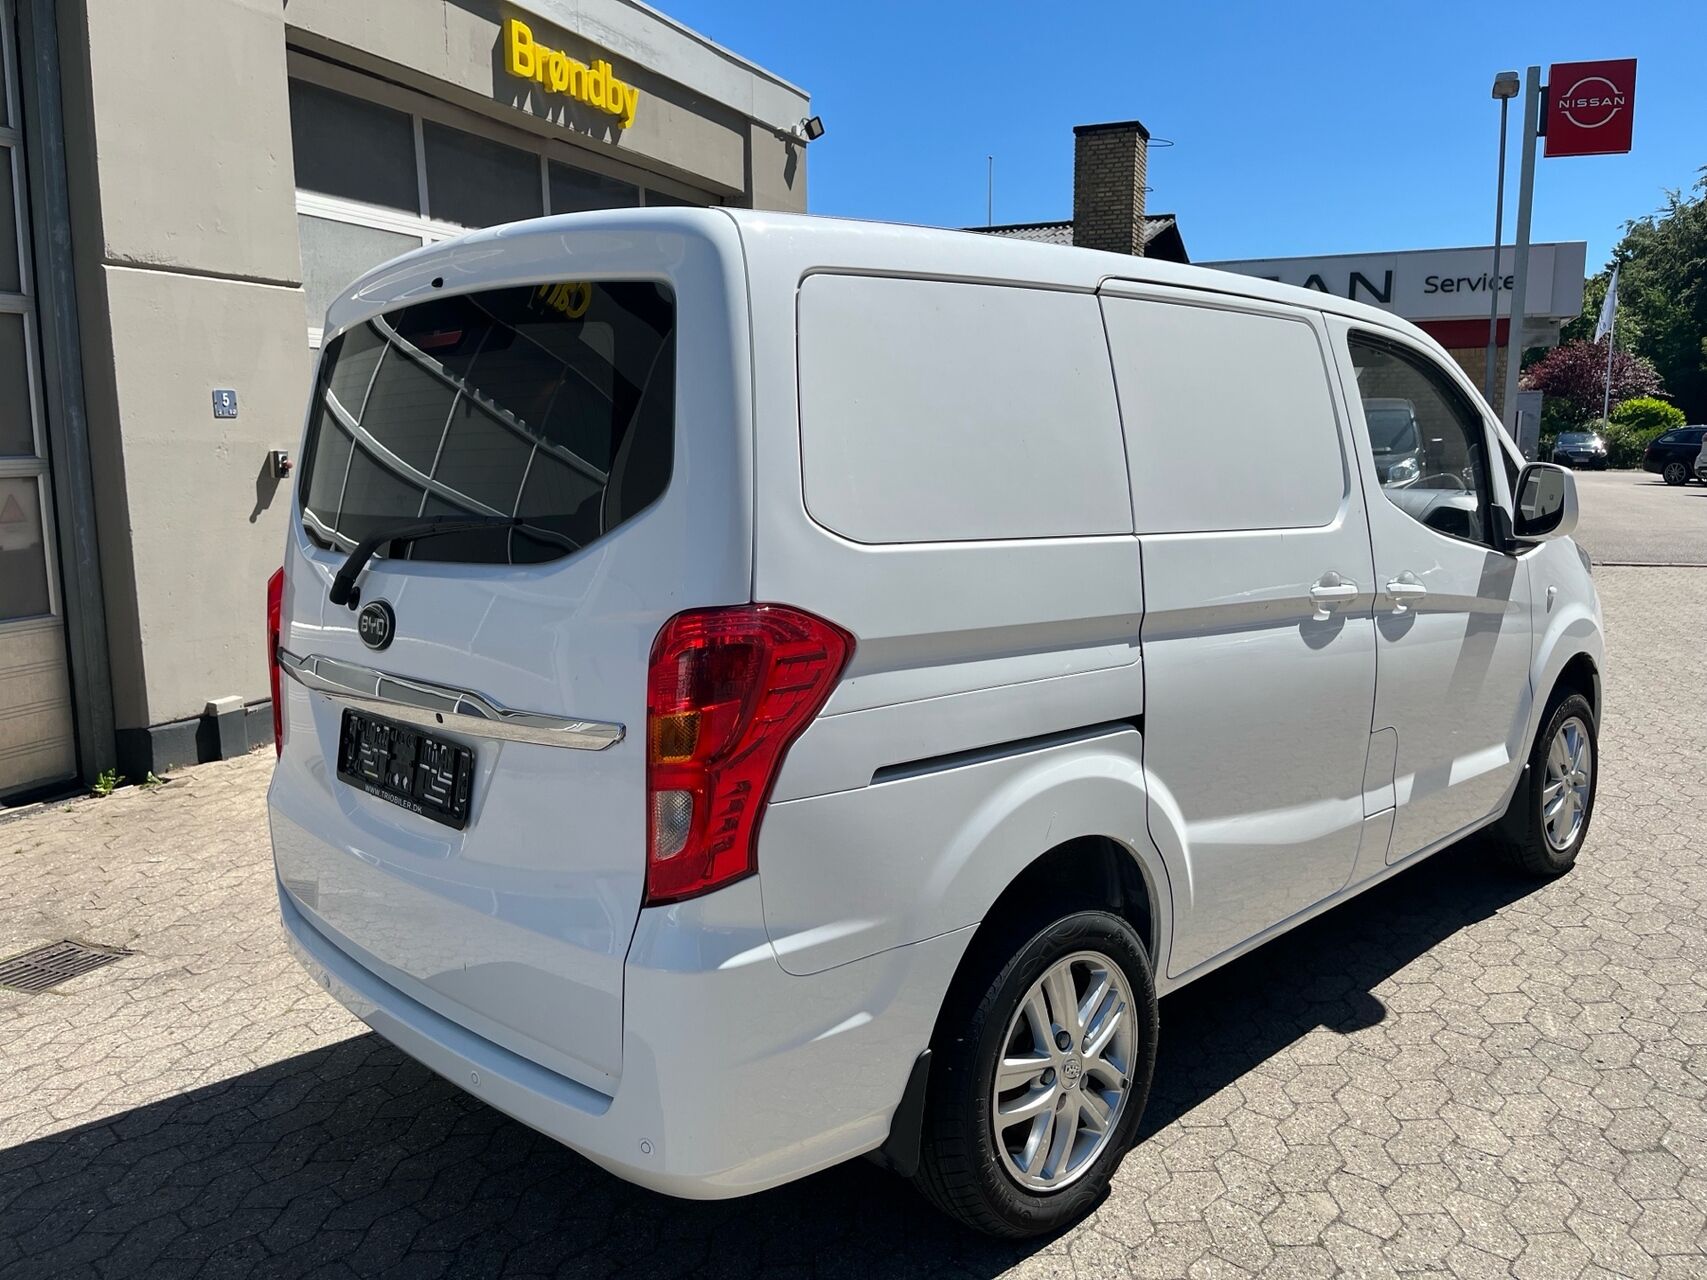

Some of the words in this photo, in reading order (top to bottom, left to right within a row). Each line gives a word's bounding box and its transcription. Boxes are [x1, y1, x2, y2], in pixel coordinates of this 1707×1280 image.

[506, 17, 640, 129] Brøndby
[1559, 97, 1625, 109] NISSAN
[1262, 270, 1393, 303] AN
[1424, 273, 1515, 293] Service
[222, 392, 230, 407] 5
[361, 615, 385, 635] BYD
